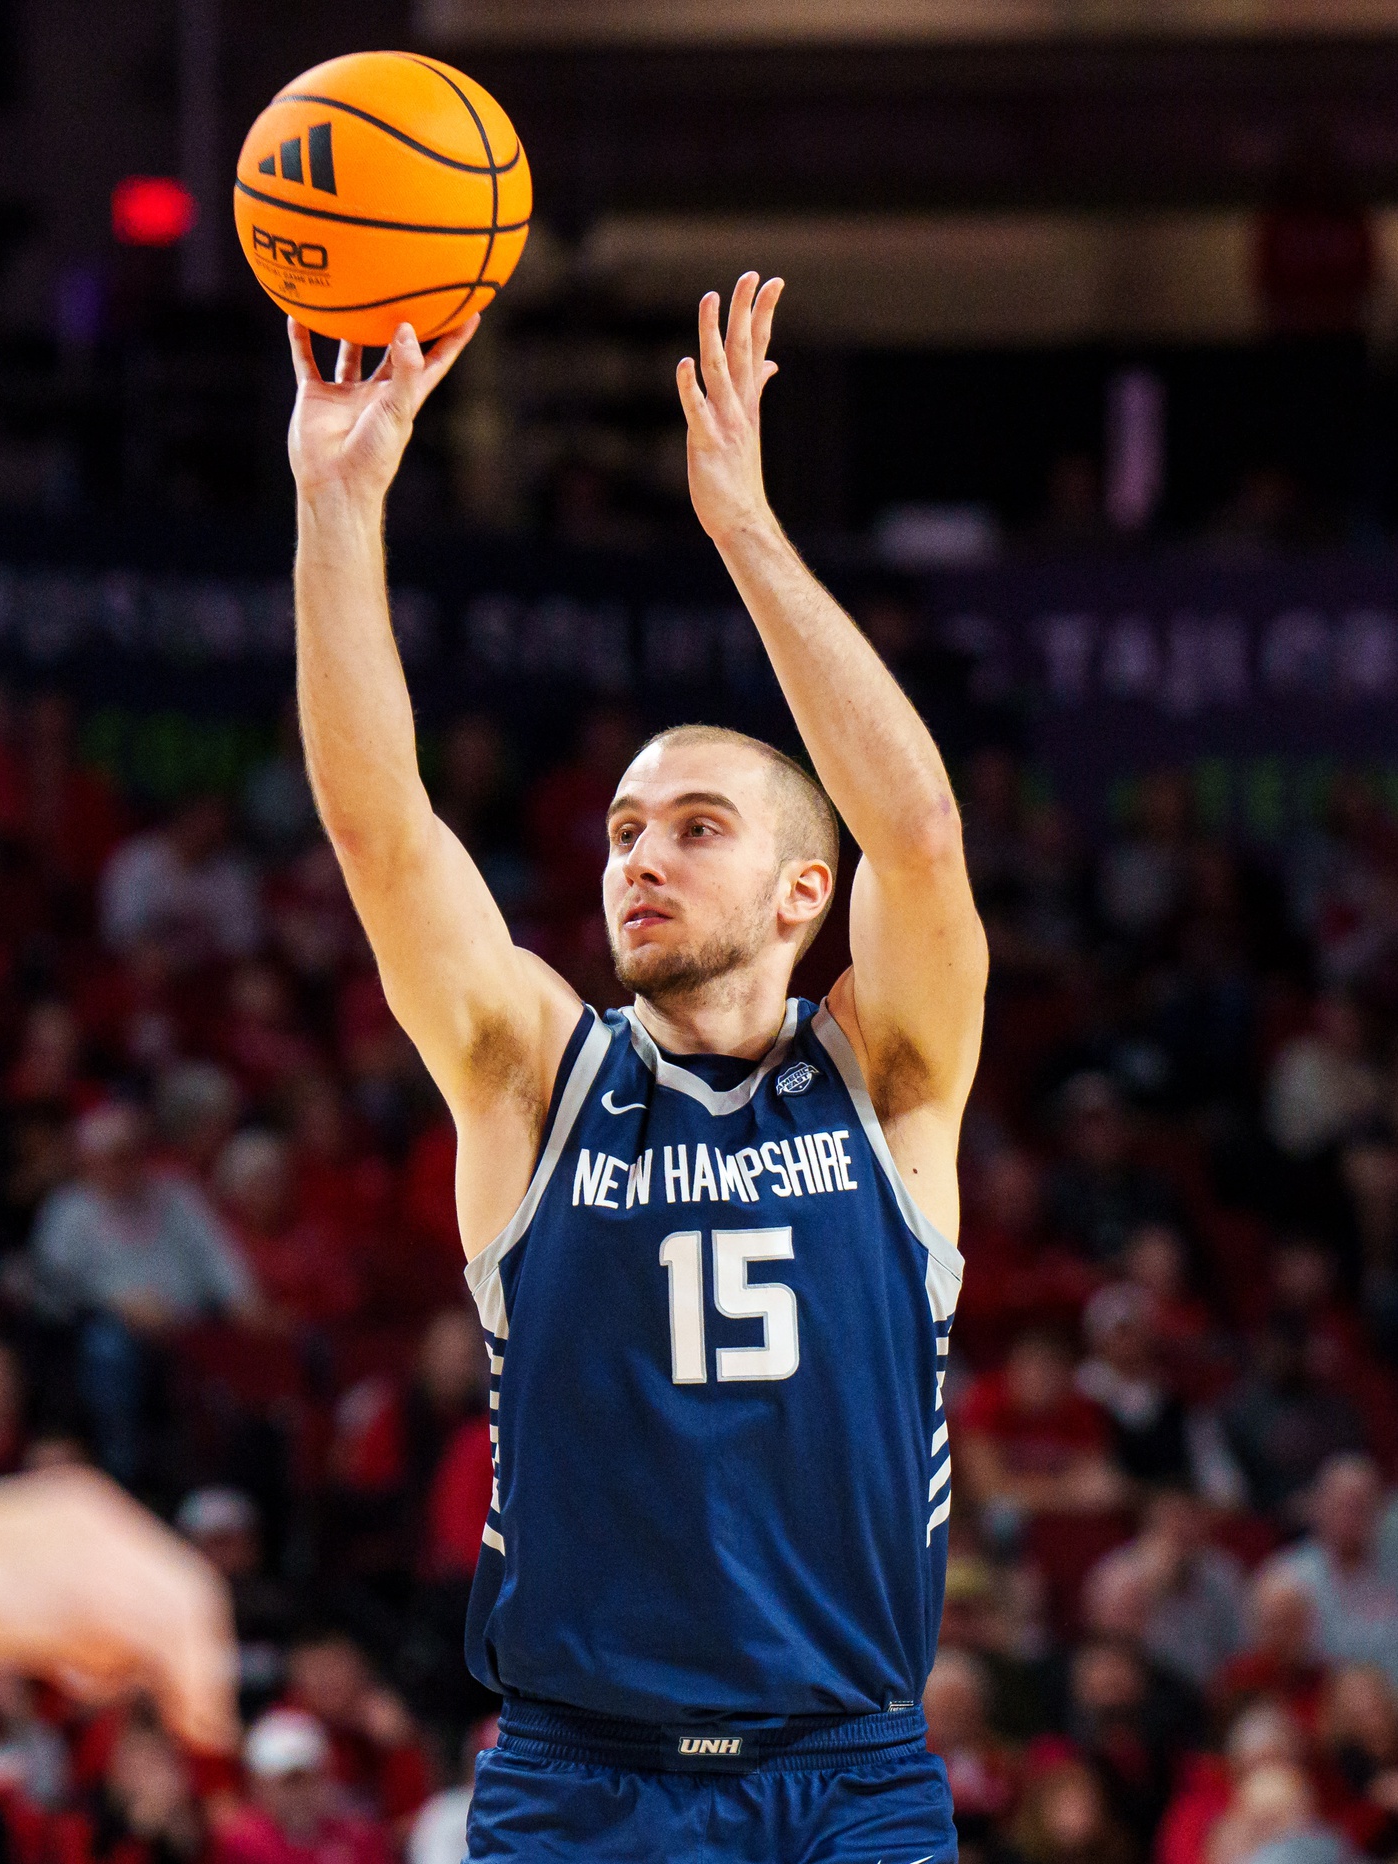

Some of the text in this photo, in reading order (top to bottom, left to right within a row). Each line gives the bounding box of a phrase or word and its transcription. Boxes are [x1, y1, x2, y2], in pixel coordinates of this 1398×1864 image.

[252, 225, 328, 270] PRO
[787, 1073, 810, 1090] EAST
[572, 1130, 858, 1209] NEW HAMPSHIRE
[659, 1226, 800, 1384] 15
[679, 1738, 742, 1755] UNH
